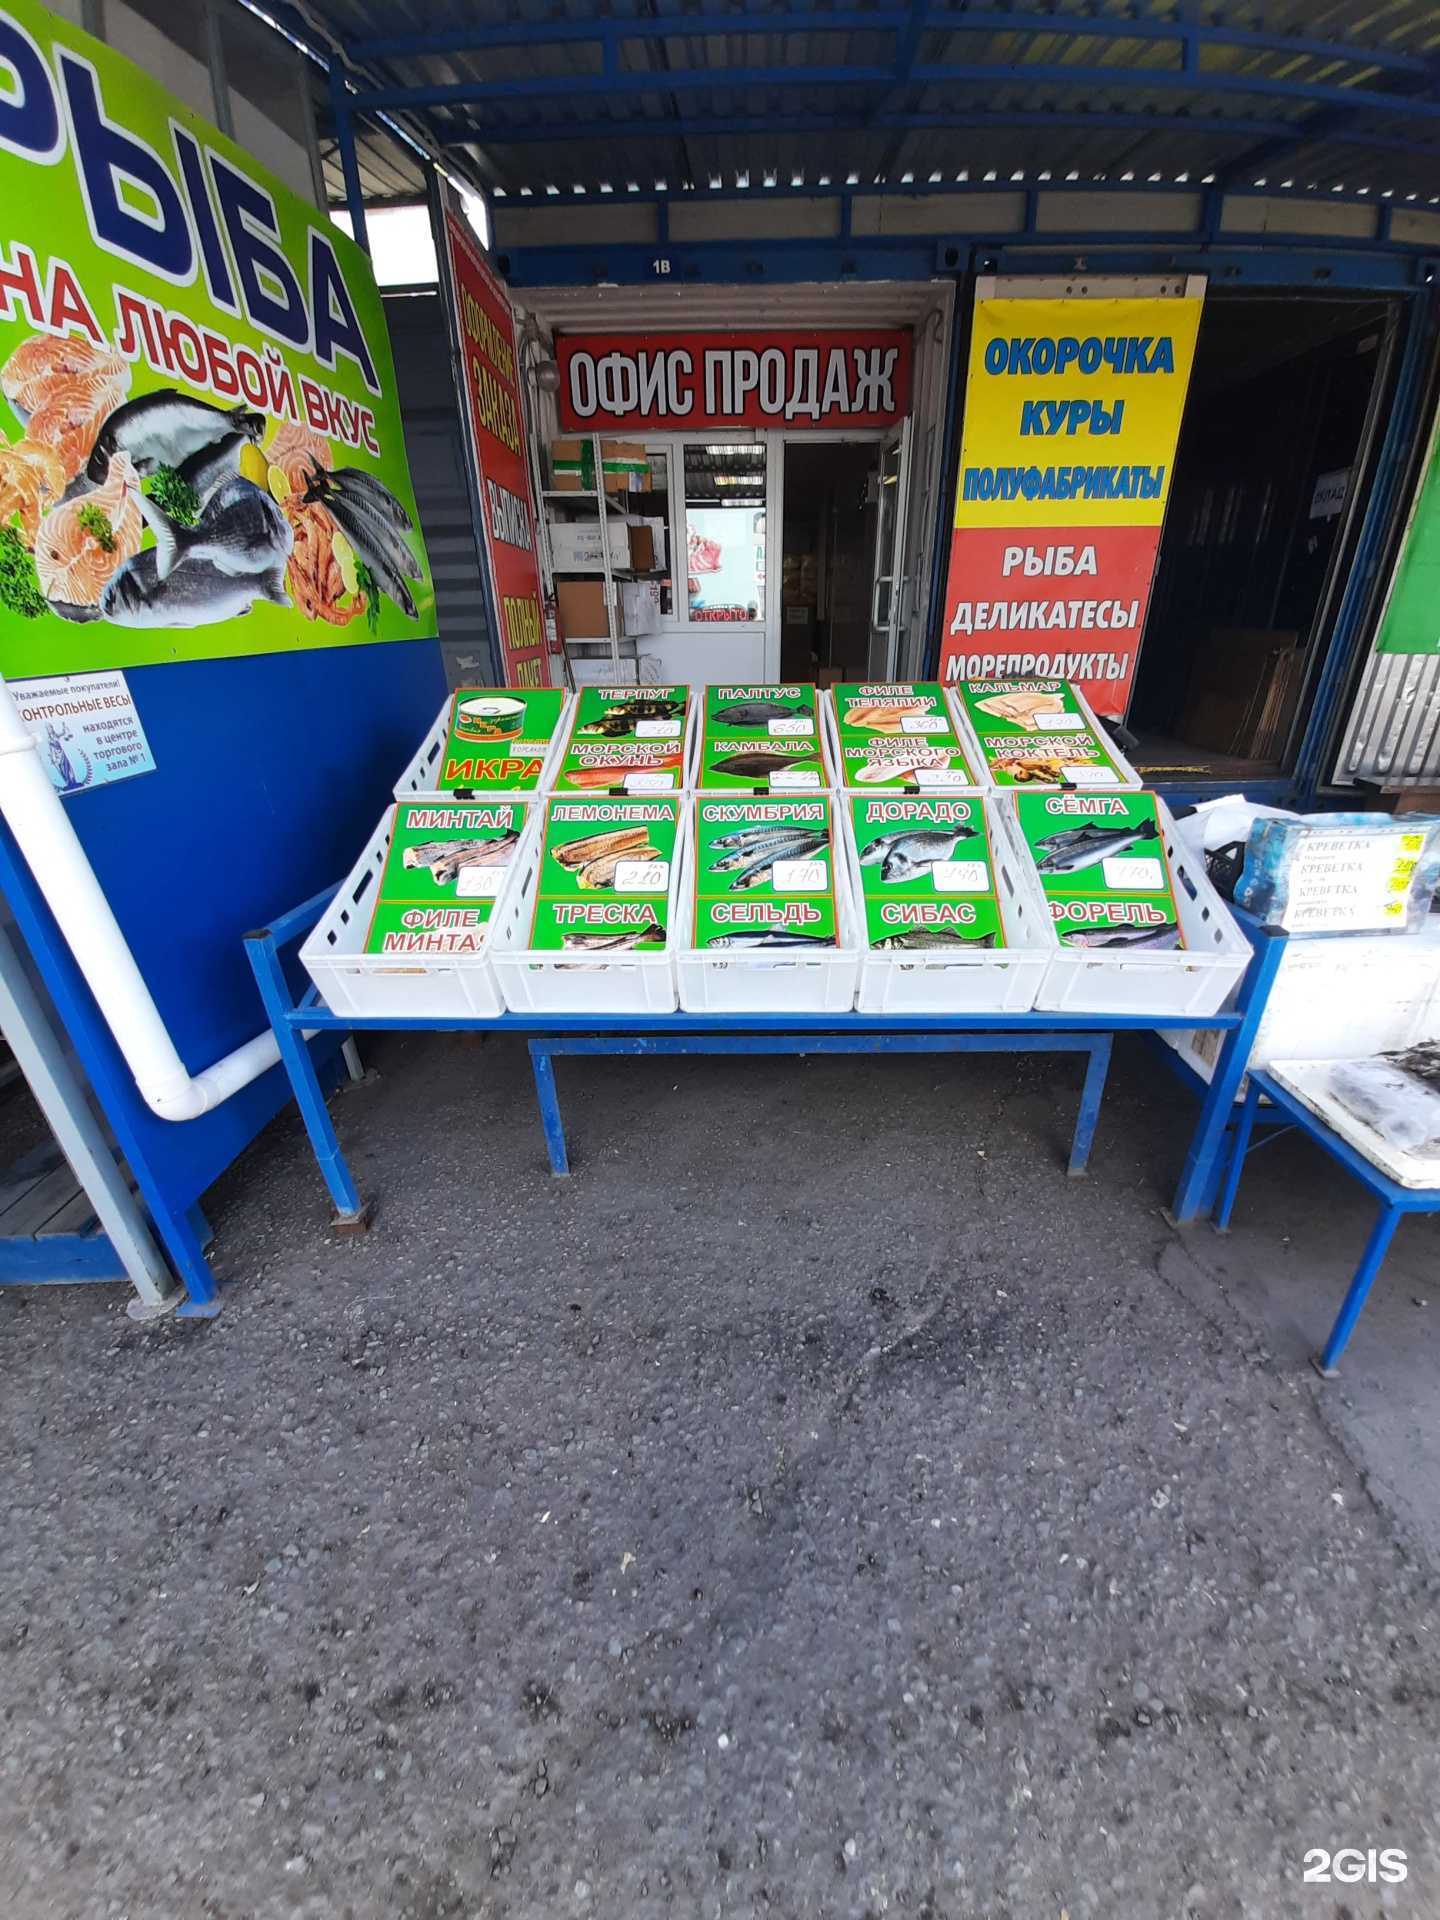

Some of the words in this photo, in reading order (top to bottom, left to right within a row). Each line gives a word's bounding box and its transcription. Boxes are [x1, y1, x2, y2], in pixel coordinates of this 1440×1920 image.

[985, 337, 1175, 375] ОКОРОЧКА
[115, 291, 297, 420] ЛЮБОЙ
[301, 379, 380, 453] ВКУС
[569, 351, 692, 416] ОФИС
[704, 348, 898, 420] ПРОДАЖ
[473, 354, 521, 456] ЗАКАЗА
[1020, 400, 1124, 436] КУРЫ
[963, 466, 1166, 500] ПОЛУФАБРИКАТЫ
[487, 479, 532, 550] ВЫПИСКА
[1002, 545, 1098, 577] РЫБА
[504, 591, 542, 649] ПОЛНЫЙ
[695, 608, 748, 621] ОТКРЫТО
[950, 601, 1140, 635] ДЕЛИКАТЕСЫ
[945, 653, 1129, 682] МОРЕПРОДУКТЫ
[13, 688, 69, 701] Уважаемые
[599, 688, 674, 701] ТЕРПУГ
[719, 688, 801, 700] ПАЛТУС
[858, 686, 914, 696] ФИЛЕ
[969, 682, 1061, 693] КАЛЬМАР
[22, 698, 102, 722] ОНТРОЛЬНЫЕ
[103, 694, 131, 709] ВЕСЫ
[83, 717, 133, 733] находятся
[96, 737, 102, 745] в
[105, 729, 138, 744] центре
[868, 738, 929, 748] ФИЛЕ
[984, 735, 1094, 747] МОРСКОЙ
[93, 743, 143, 761] торгового
[571, 741, 681, 755] МОРСКОЙ
[715, 742, 814, 753] КАМБАЛА
[846, 748, 960, 758] МОРСКОГО
[994, 748, 1099, 759] КОКТЕЛЬ
[106, 759, 128, 772] зала
[447, 758, 544, 780] ИКРА
[579, 754, 663, 767] ОКУНЬ
[868, 757, 943, 767] ЯЗЫКА
[551, 805, 674, 821] ЛЕМОНЕМА
[703, 804, 824, 820] СКУМБРИЯ
[866, 803, 971, 822] ДОРАДО
[1045, 795, 1129, 815] СЁМГА
[407, 806, 513, 828] МИНТАЙ
[402, 909, 479, 929] ФИЛЕ
[553, 904, 657, 923] ТРЕСКА
[711, 903, 821, 924] СЕЛЬДЬ
[881, 904, 976, 923] СИБАС
[1048, 902, 1167, 923] ФОРЕЛЬ
[384, 933, 486, 952] МИНТА
